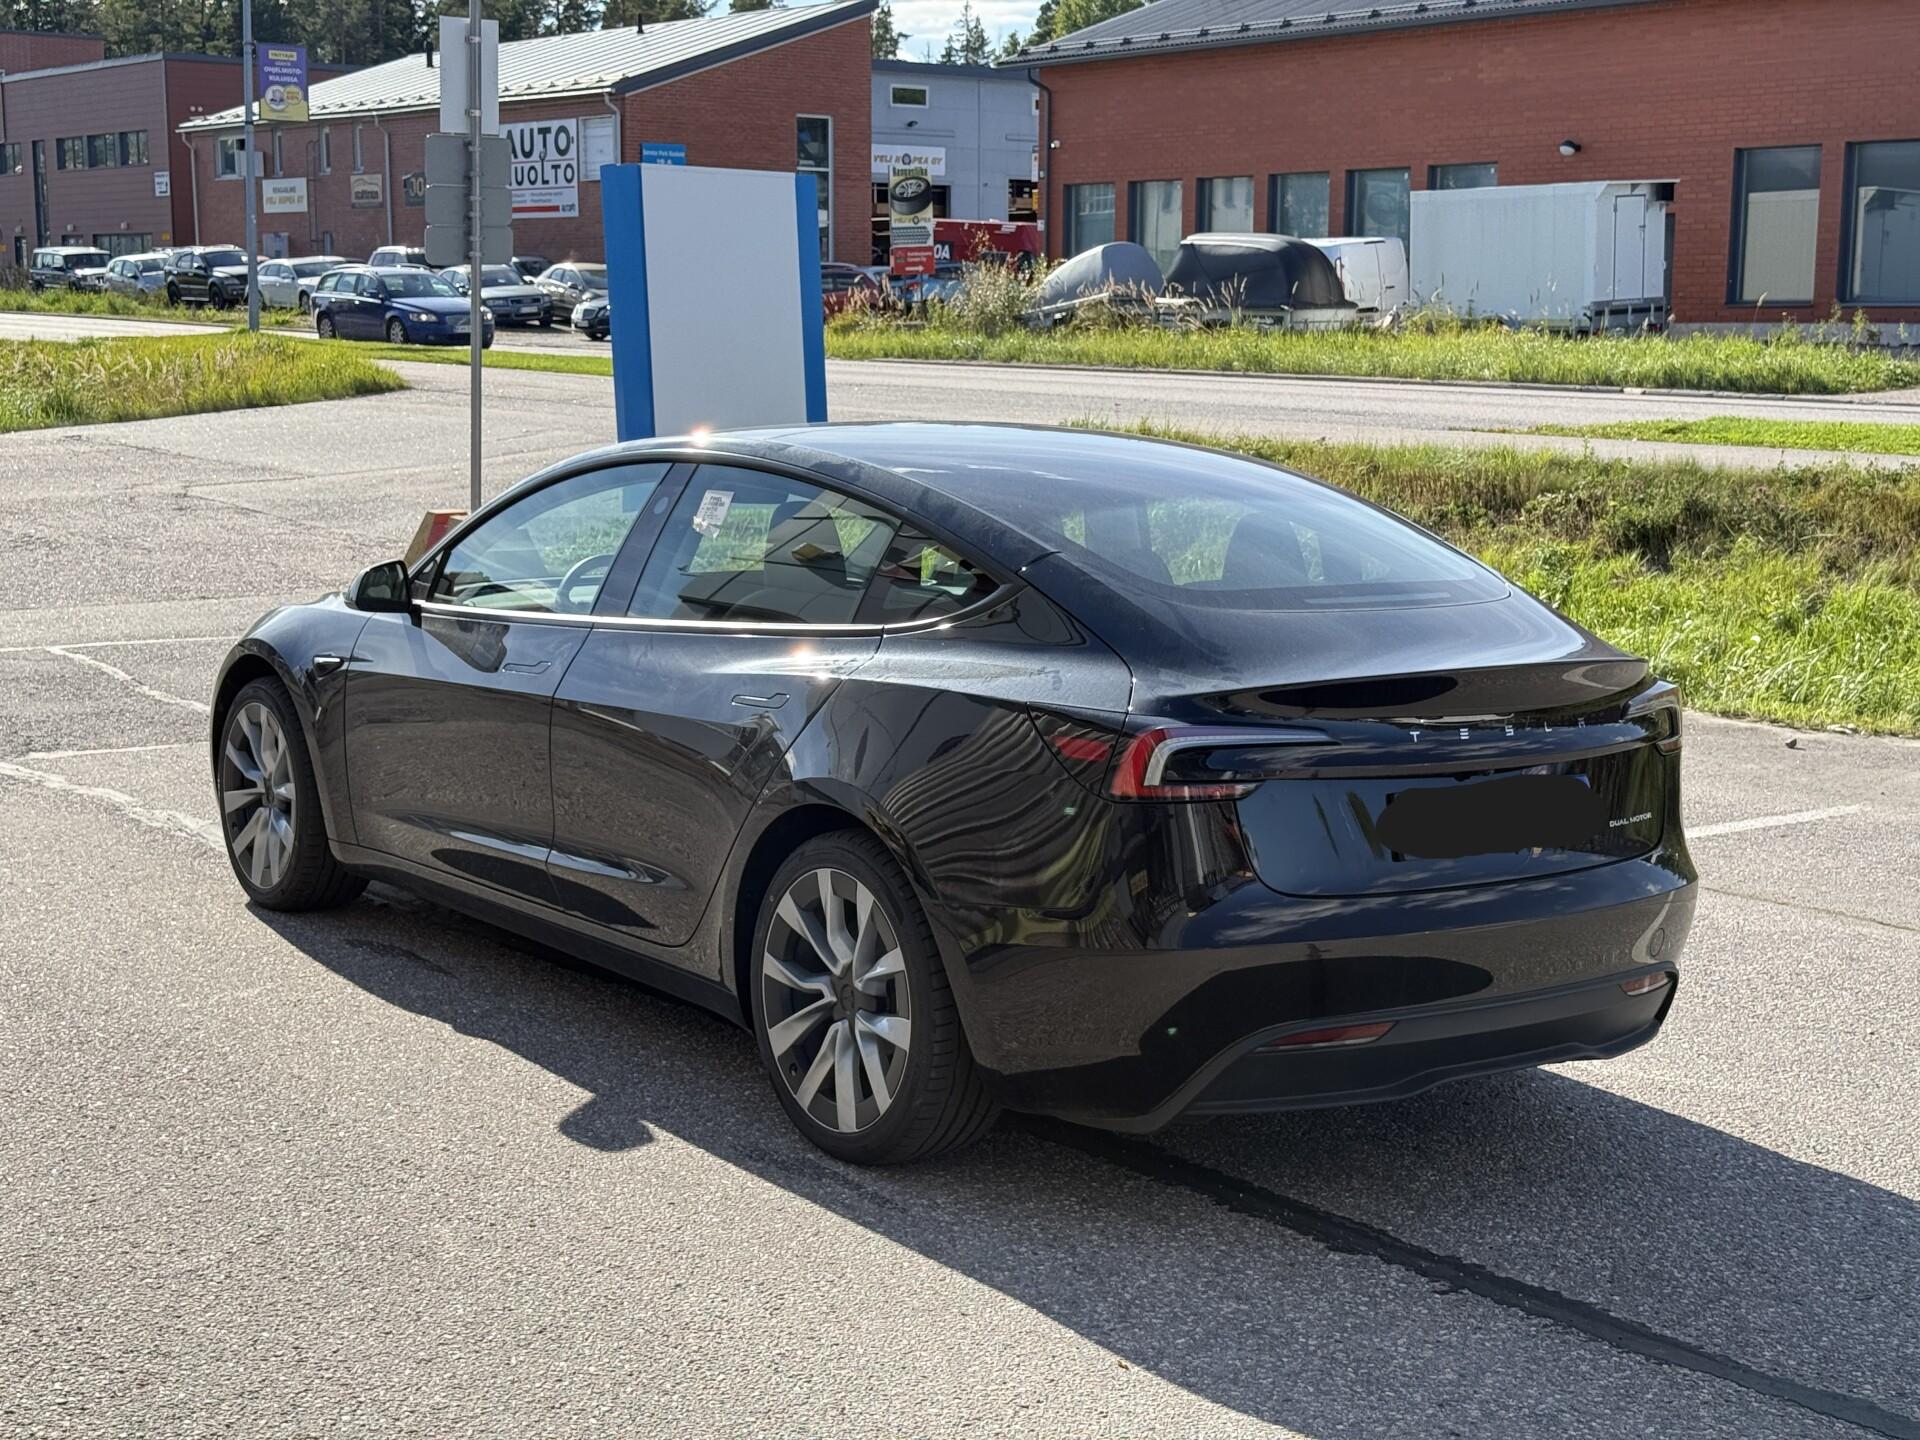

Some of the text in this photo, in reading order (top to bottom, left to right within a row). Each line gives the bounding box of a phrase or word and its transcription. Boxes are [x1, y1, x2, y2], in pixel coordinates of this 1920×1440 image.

[509, 163, 575, 187] UOLTO
[1409, 717, 1586, 743] TESLA
[1609, 811, 1652, 828] DUAL MOTOR
